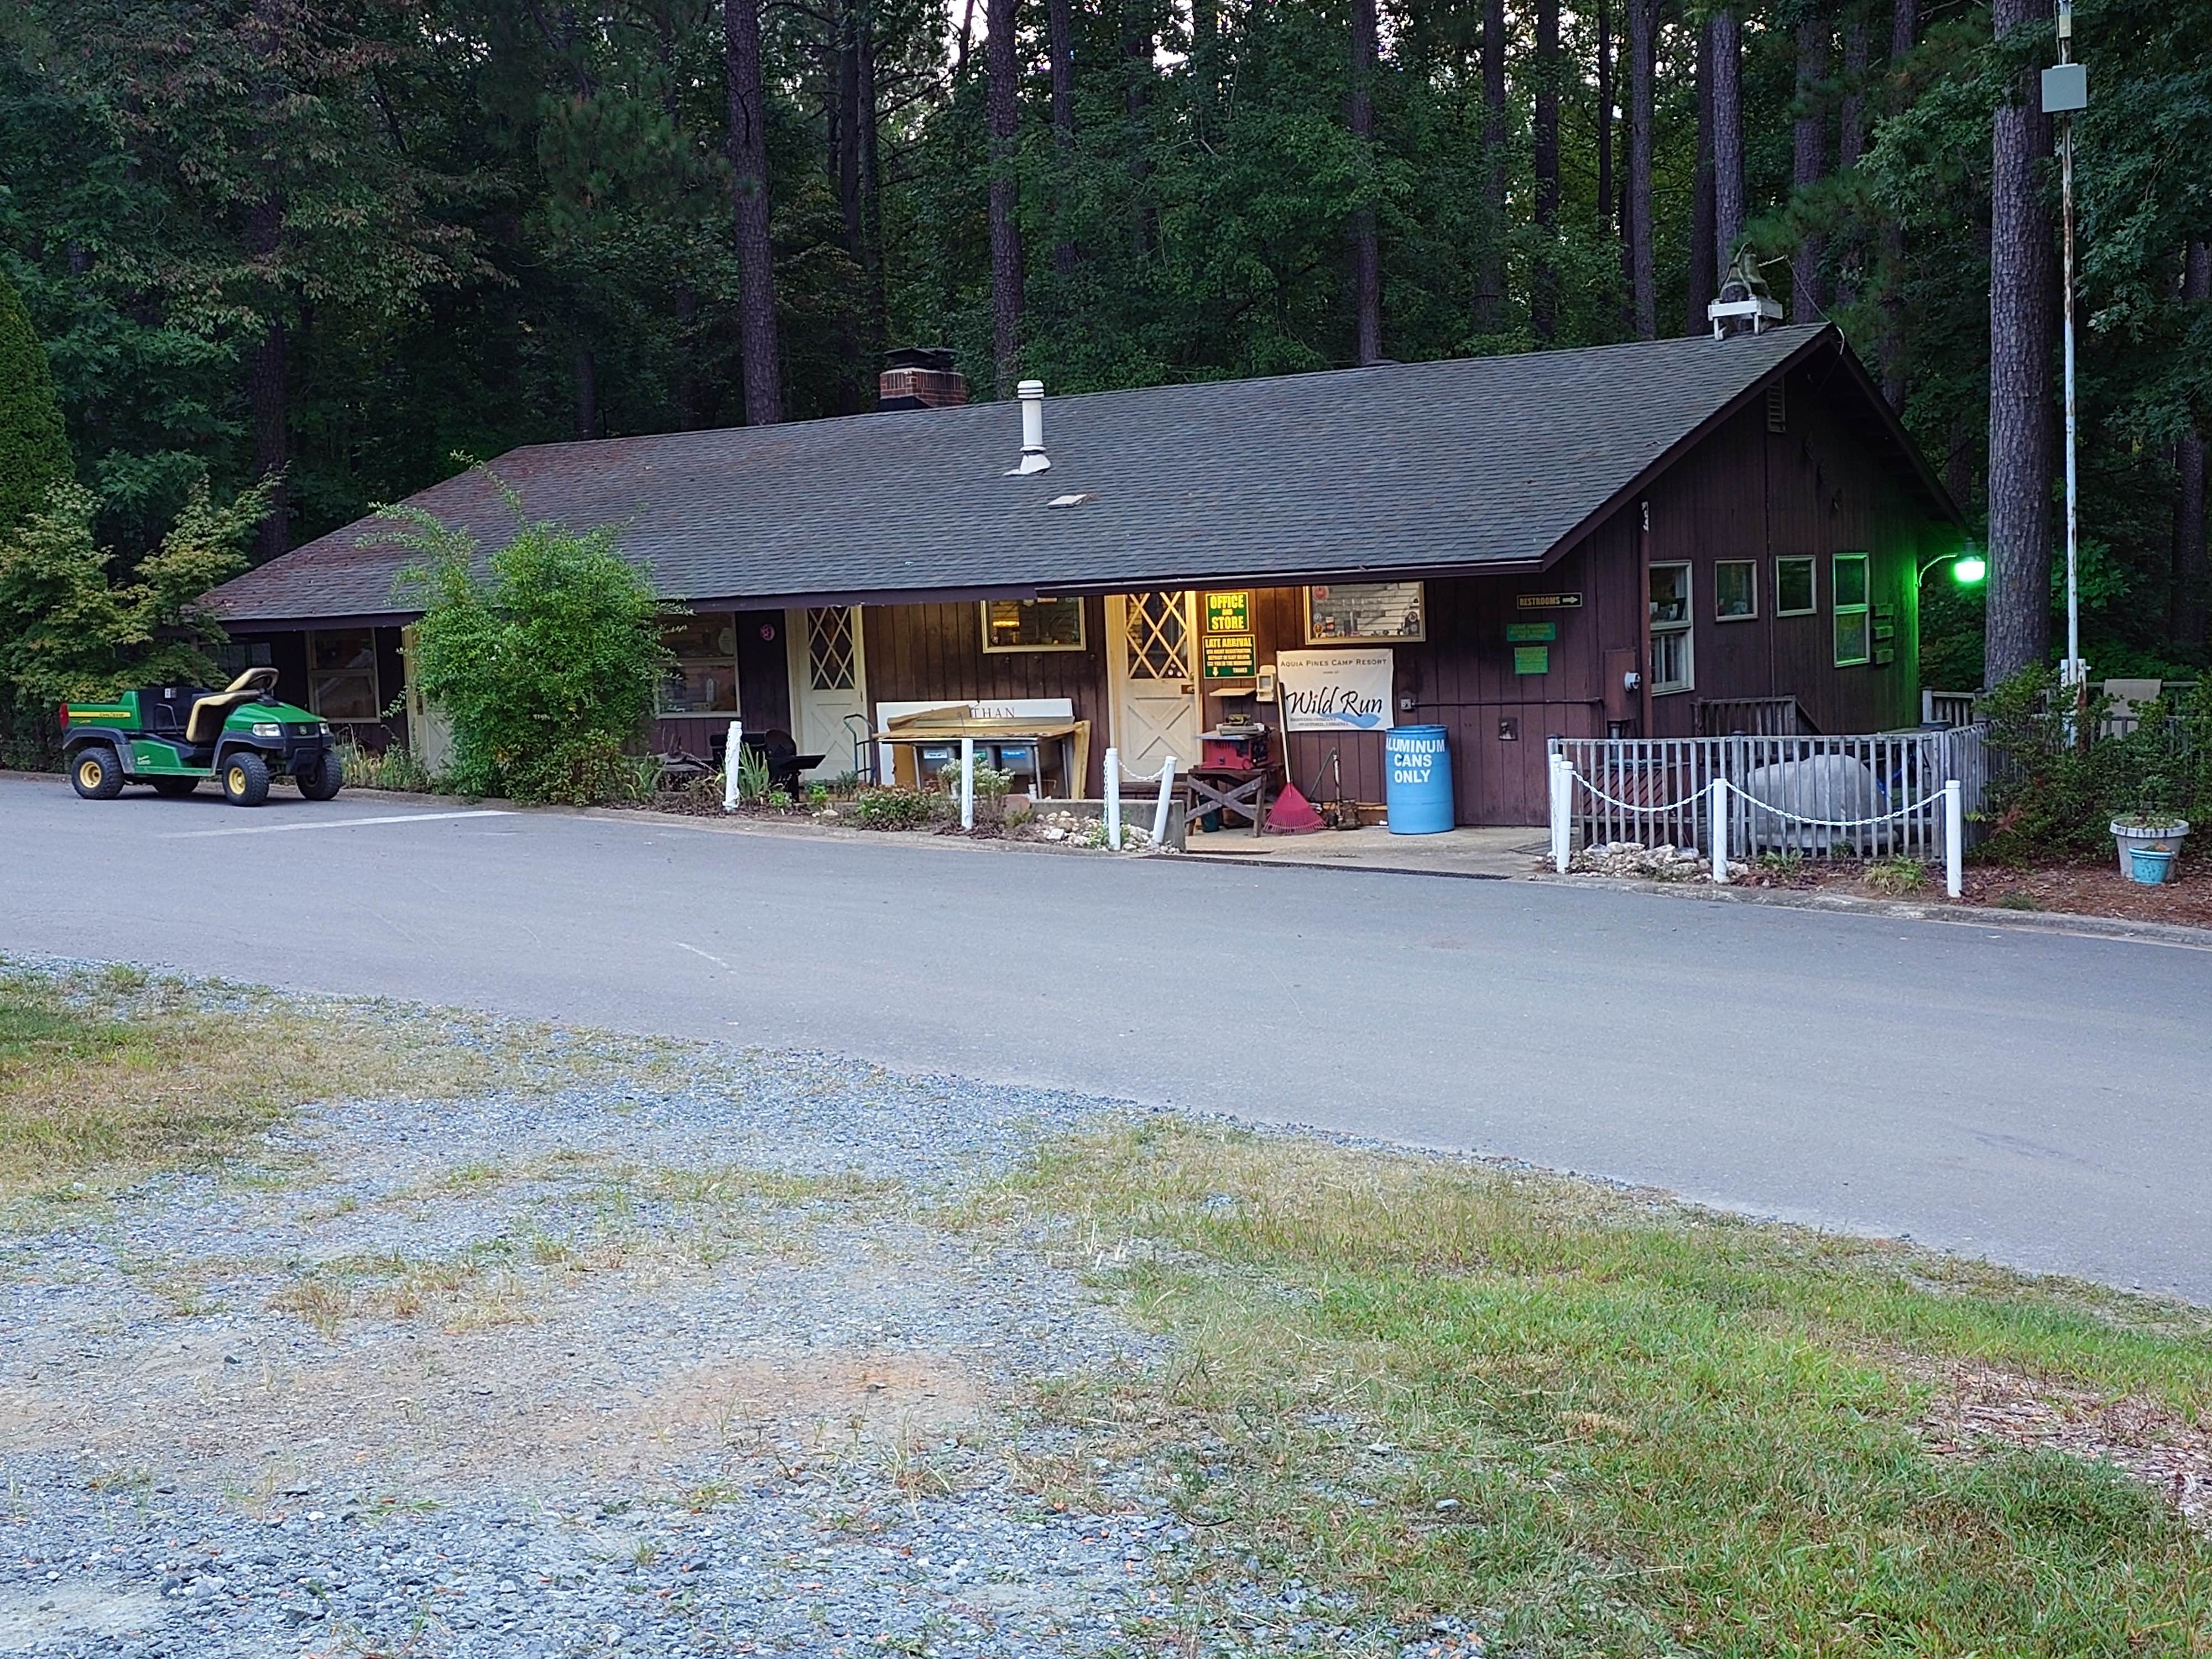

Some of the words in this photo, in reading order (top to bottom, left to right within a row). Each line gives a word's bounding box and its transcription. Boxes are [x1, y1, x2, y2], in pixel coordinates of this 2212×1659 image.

[1210, 594, 1244, 609] OFFICE
[1520, 597, 1560, 606] RESTROOMS
[1212, 615, 1244, 630] STORE
[1205, 638, 1221, 648] LATE
[1222, 637, 1252, 648] ARRIVAL
[1286, 686, 1339, 714] Wild
[1340, 691, 1383, 717] Run
[1394, 753, 1432, 767] CANS
[1394, 769, 1431, 783] ONLY
